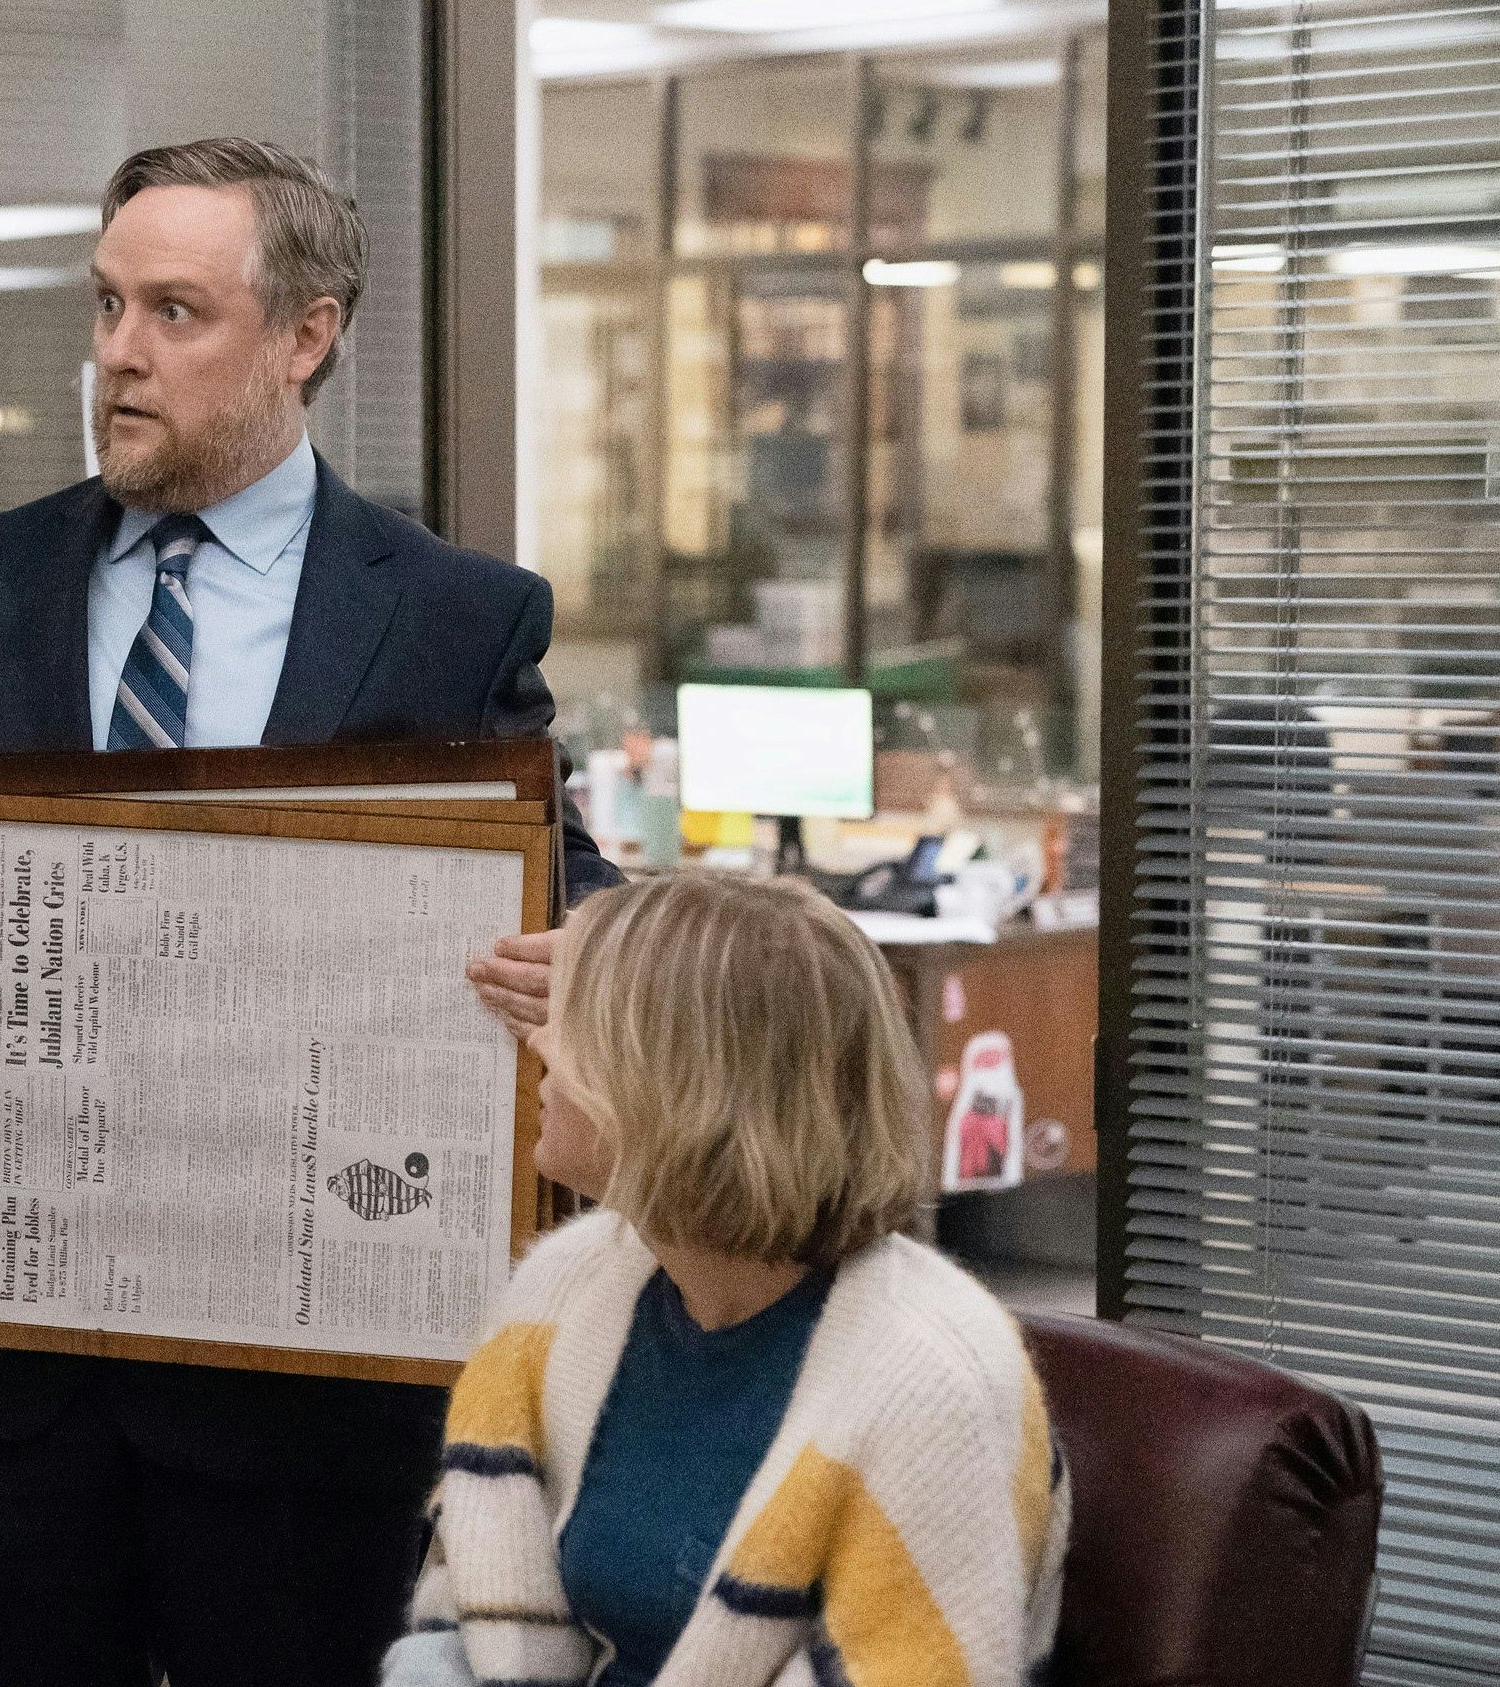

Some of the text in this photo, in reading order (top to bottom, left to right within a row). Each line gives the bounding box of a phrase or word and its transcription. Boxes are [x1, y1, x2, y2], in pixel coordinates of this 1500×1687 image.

[82, 841, 94, 892] Deal With
[98, 853, 110, 862] K
[114, 841, 130, 894] Urges U.S.
[8, 849, 36, 947] Celebrate,
[42, 861, 65, 910] Cries
[40, 917, 64, 982] Nation
[159, 909, 173, 958] Bobby Firm
[174, 910, 186, 959] In Stand On
[188, 911, 202, 960] Civil Rights
[11, 955, 29, 975] to
[6, 982, 29, 1031] Time
[38, 988, 64, 1070] Jubilant
[73, 974, 86, 1065] Shepard to Receive
[87, 960, 102, 1065] Wild Capital Welcome
[304, 1036, 326, 1097] County
[78, 1085, 90, 1126] Honor
[3, 1088, 13, 1184] BRITON JOINS ALAN
[15, 1129, 23, 1172] GETTING
[78, 1127, 90, 1143] of
[93, 1098, 110, 1184] Due Shepard?
[14, 1174, 22, 1185] IN
[77, 1146, 89, 1182] Medal
[25, 1197, 41, 1244] Jobless
[60, 1218, 69, 1238] Plan
[298, 1208, 314, 1249] State
[0, 1196, 21, 1302] Retraining Plan
[24, 1247, 39, 1269] for
[60, 1239, 68, 1270] Million
[46, 1269, 56, 1298] Budget
[58, 1288, 67, 1300] To
[295, 1250, 313, 1326] Outdated
